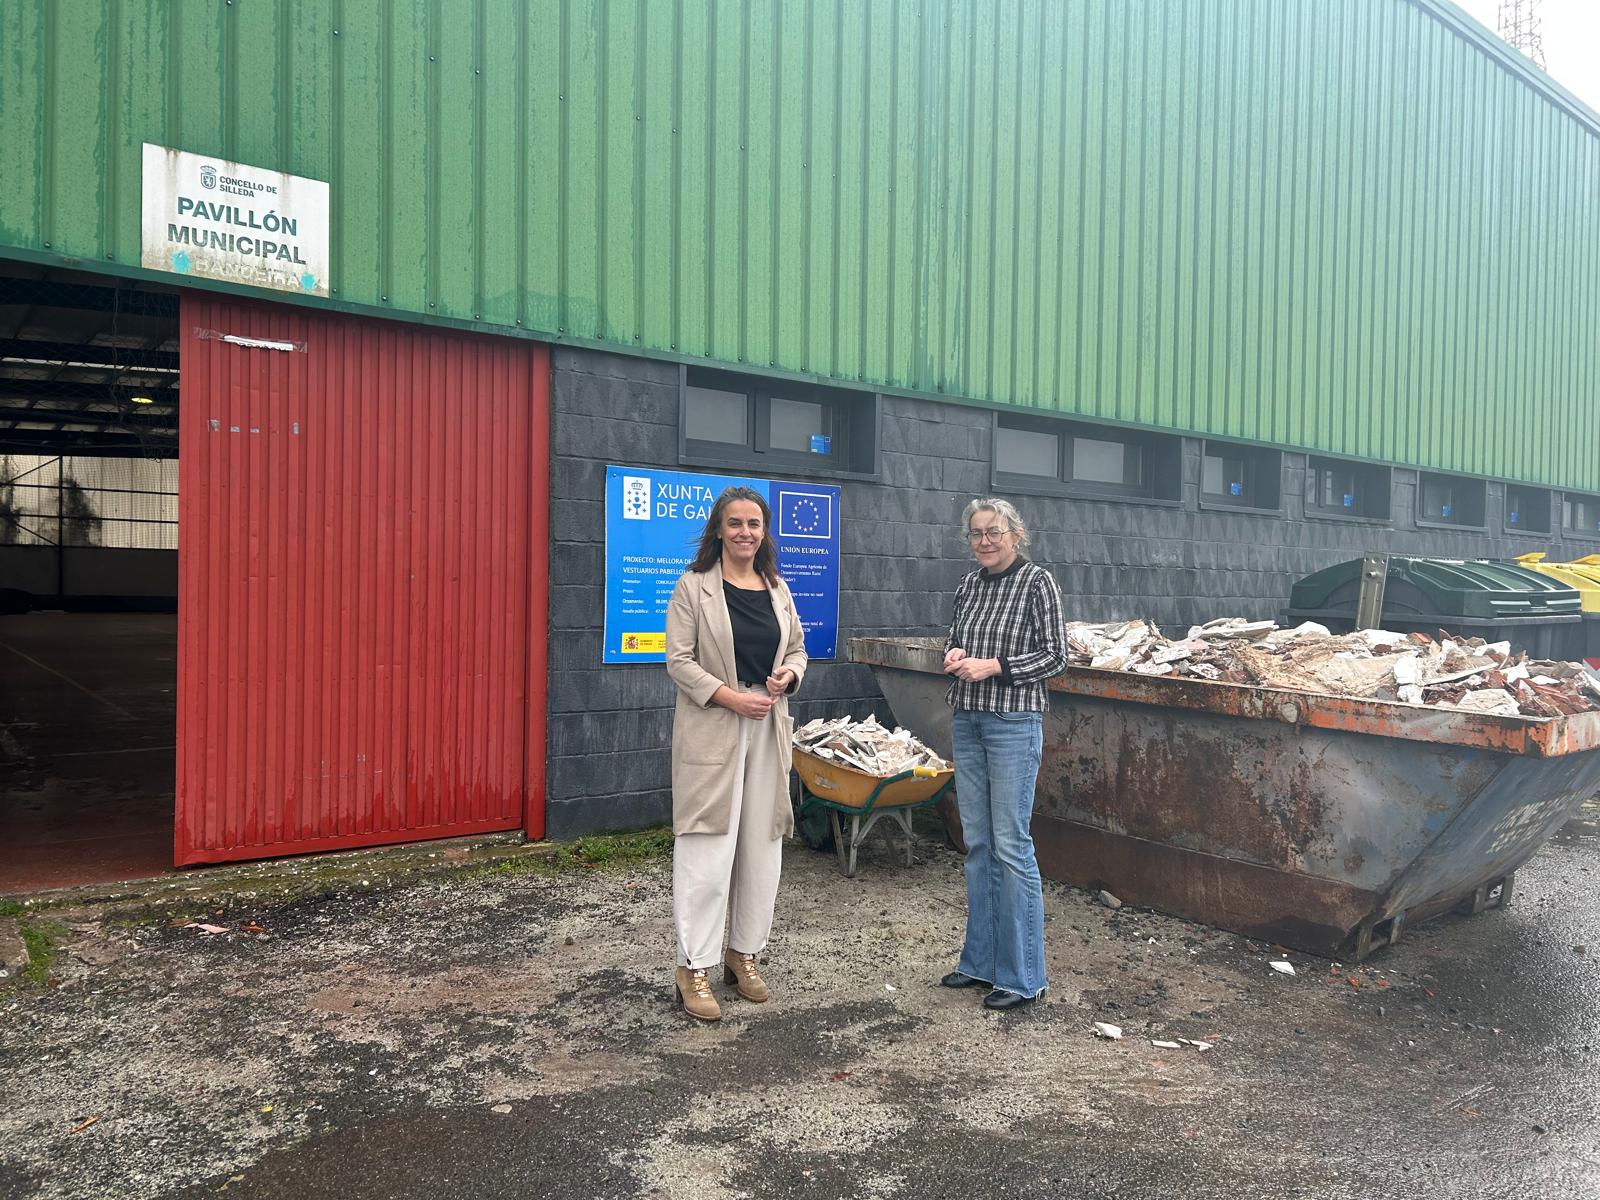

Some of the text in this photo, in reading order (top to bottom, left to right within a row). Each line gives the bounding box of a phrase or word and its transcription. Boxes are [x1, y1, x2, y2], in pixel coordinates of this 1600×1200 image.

[219, 175, 278, 195] CONCELLO DE
[219, 184, 255, 198] SILLEDA
[177, 196, 297, 237] PAVILLÓN
[167, 223, 307, 265] MUNICIPAL
[656, 482, 714, 502] XUNTA
[656, 502, 678, 519] DE
